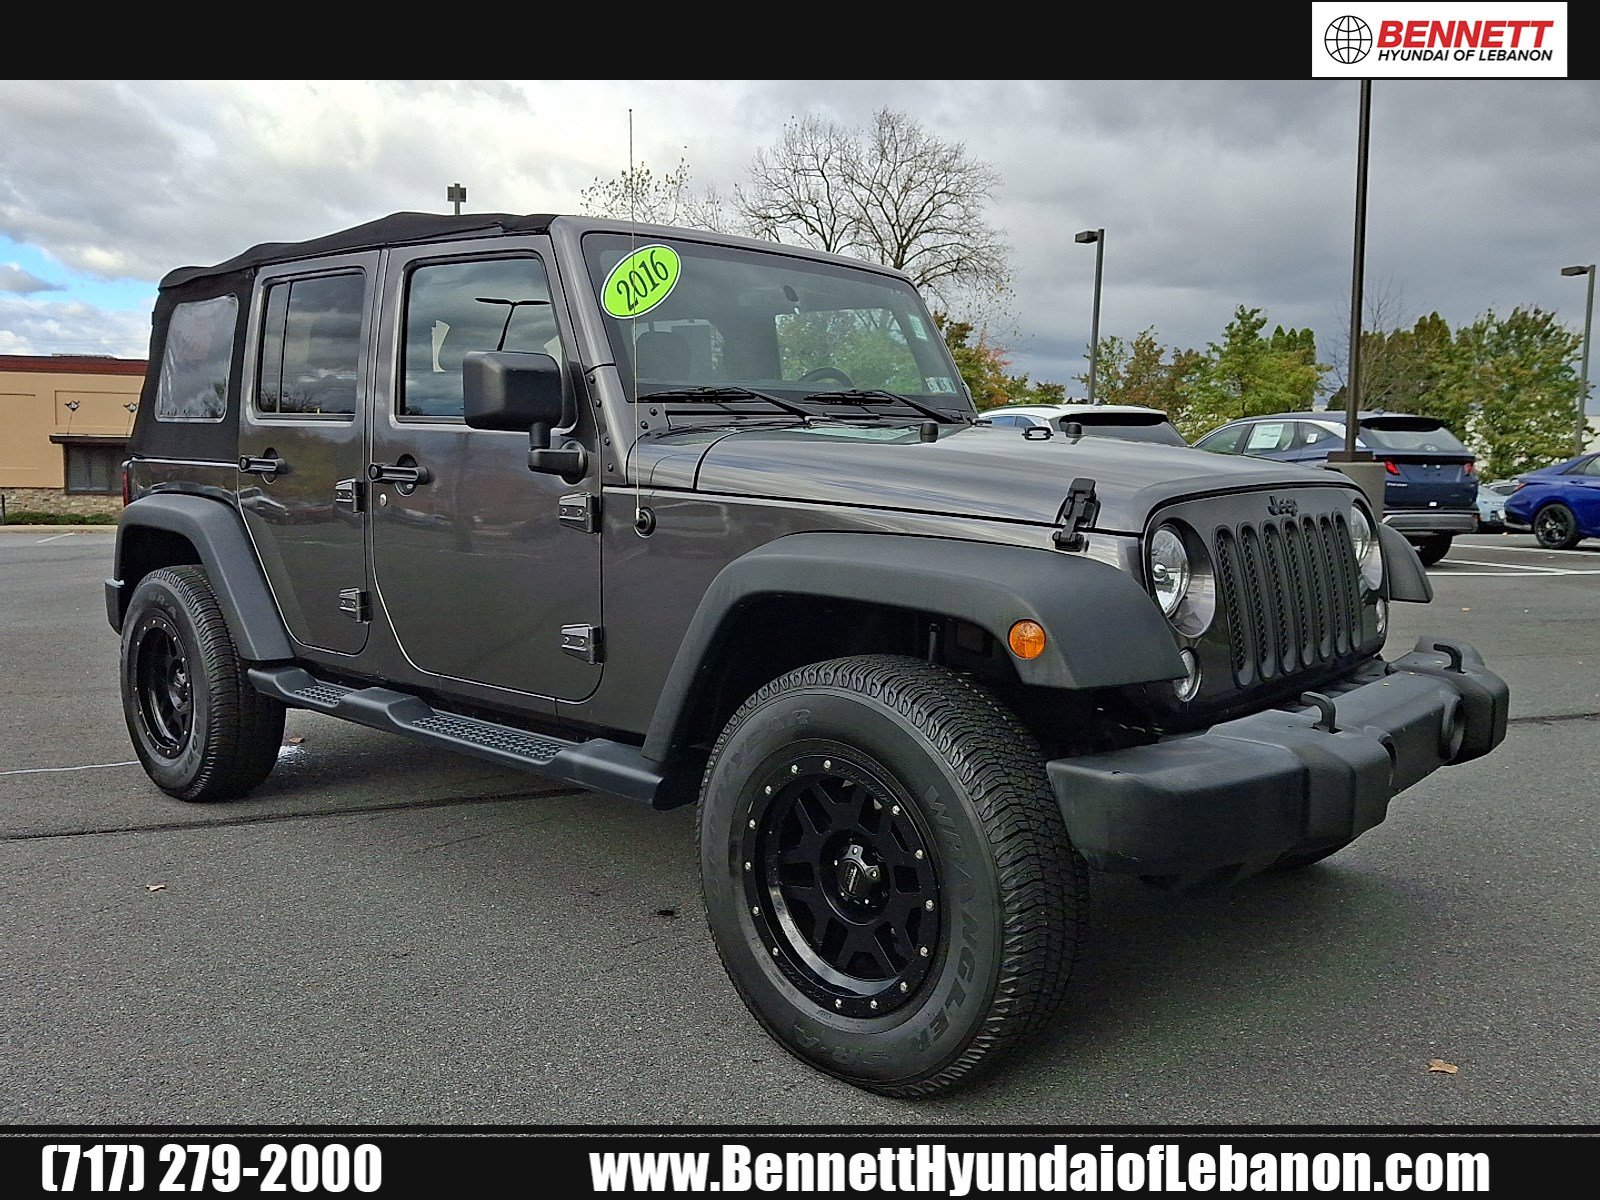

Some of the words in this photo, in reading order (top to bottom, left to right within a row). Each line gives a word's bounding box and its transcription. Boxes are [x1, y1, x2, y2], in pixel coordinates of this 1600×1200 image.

[616, 250, 669, 312] 2016
[1267, 495, 1298, 517] Jeep
[911, 783, 977, 1054] WRANGLER
